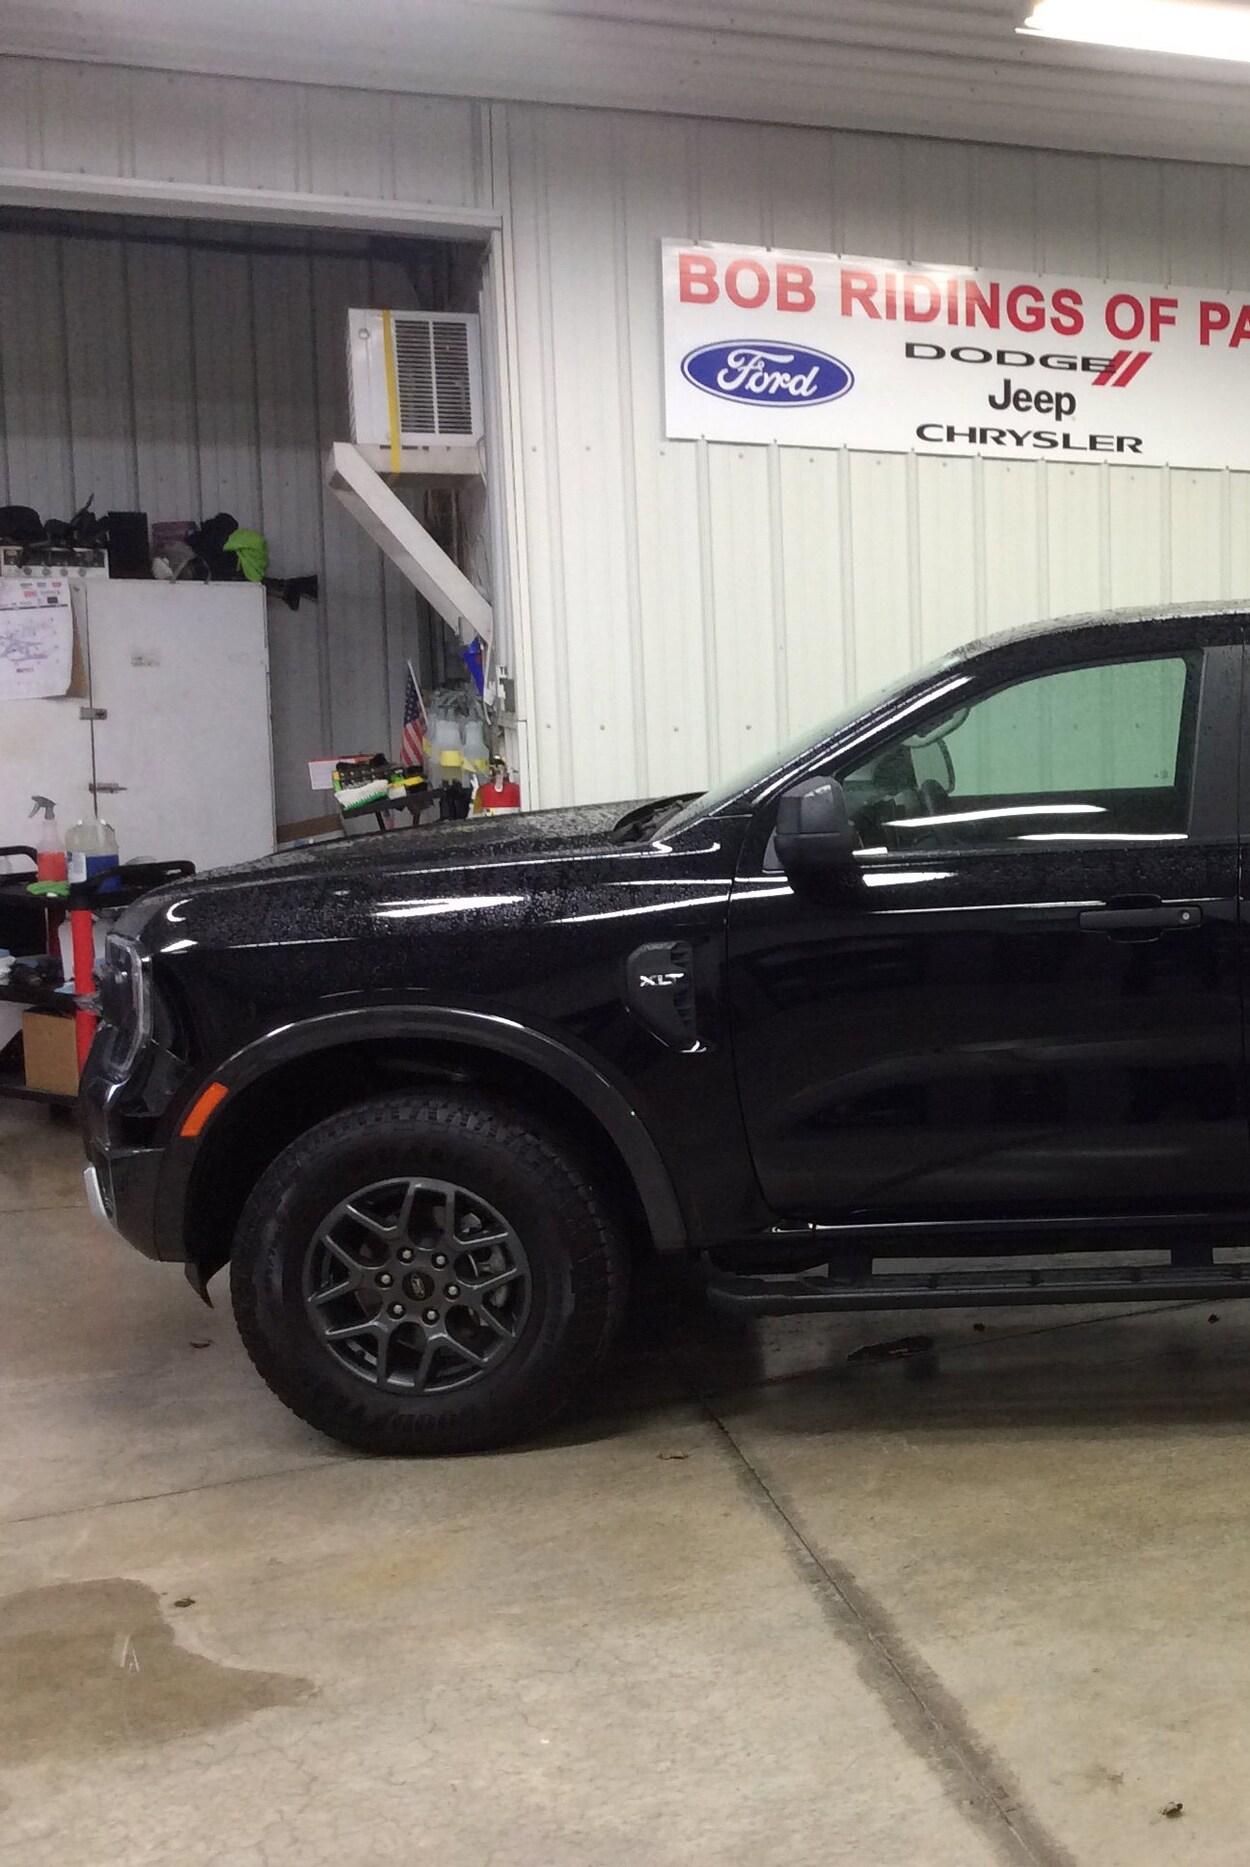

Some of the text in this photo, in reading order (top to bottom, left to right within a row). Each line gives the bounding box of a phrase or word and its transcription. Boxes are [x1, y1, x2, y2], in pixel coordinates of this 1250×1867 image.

[679, 253, 816, 313] BOB
[840, 269, 1085, 336] RIDINGS
[1105, 293, 1179, 342] OF
[717, 349, 820, 397] Ford
[905, 342, 1116, 373] DODGE
[988, 378, 1077, 421] Jeep
[916, 423, 1143, 453] CHRYSLER
[640, 973, 684, 987] XLT
